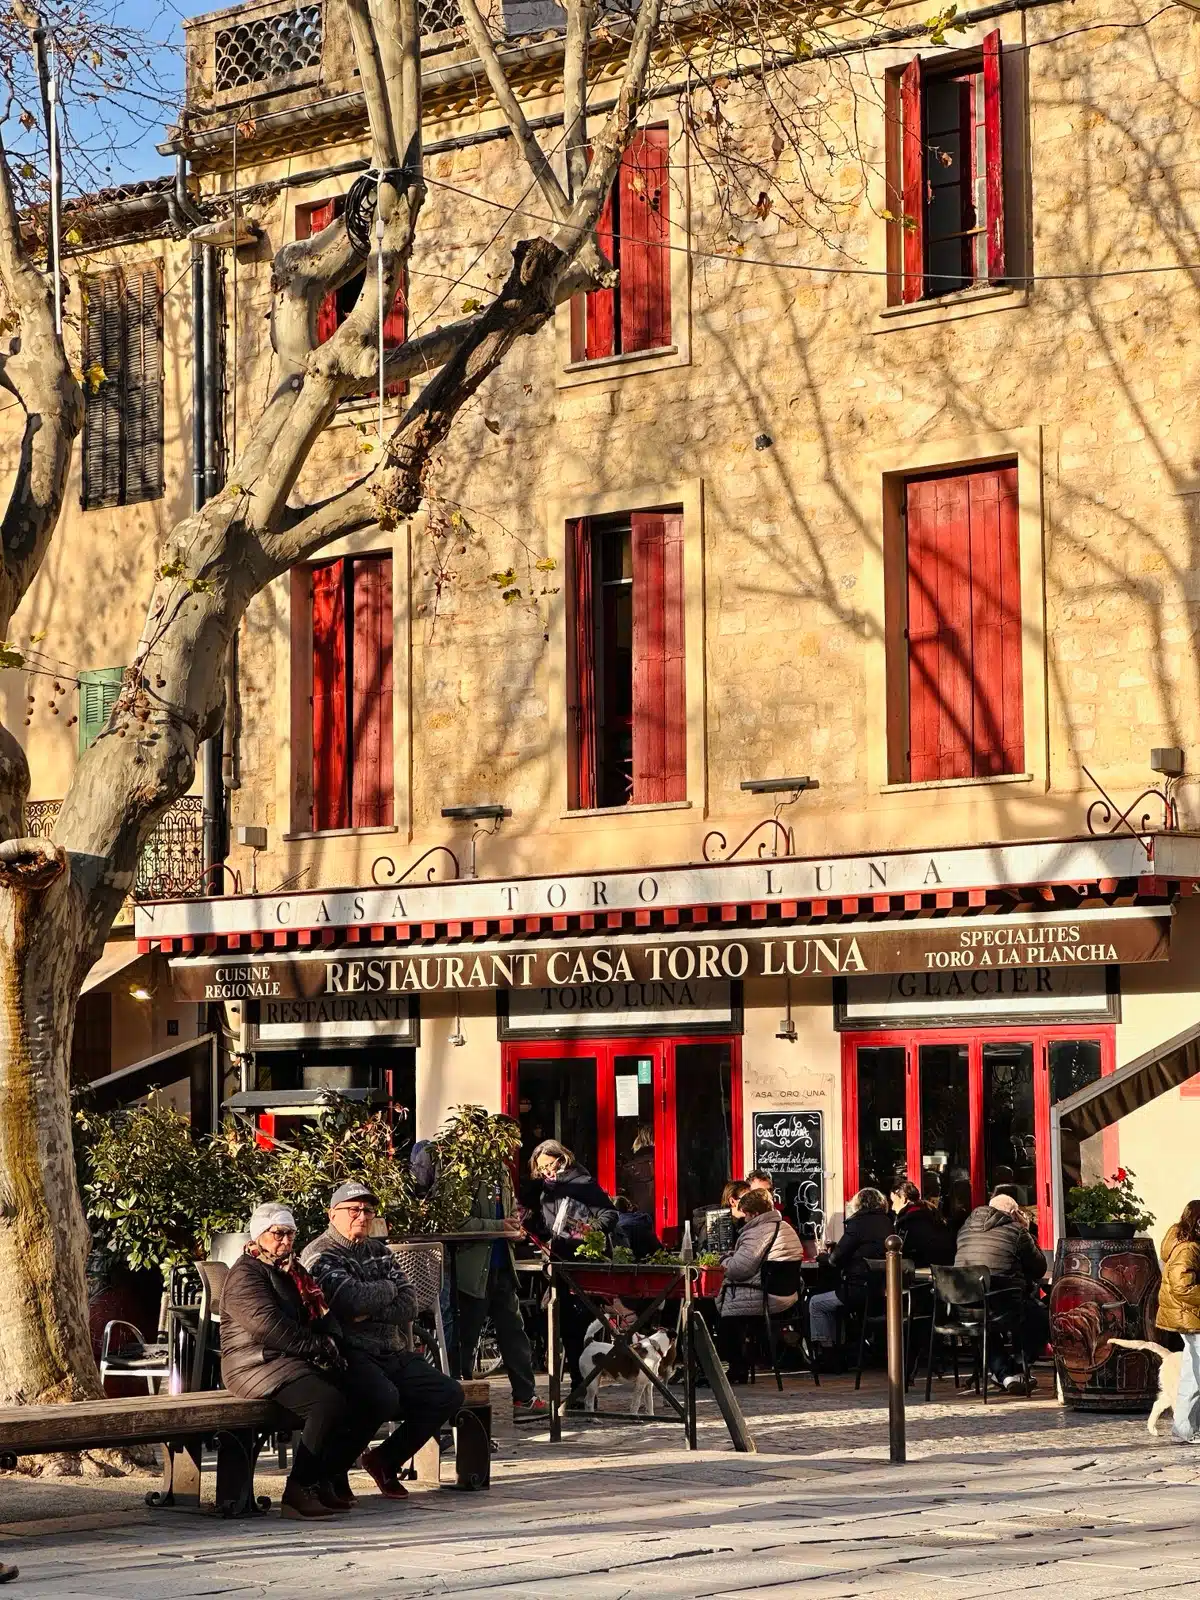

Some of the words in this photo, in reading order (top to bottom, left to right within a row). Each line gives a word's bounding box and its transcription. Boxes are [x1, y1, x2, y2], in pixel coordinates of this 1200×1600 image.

[276, 894, 407, 924] CASA
[501, 876, 659, 911] TORO
[765, 858, 943, 894] LUNA
[960, 926, 1080, 947] SPECIALITES
[324, 953, 538, 993] RESTAURANT
[546, 948, 635, 985] CASA
[644, 943, 748, 980] TORO
[760, 937, 868, 976] LUNA
[925, 947, 974, 968] TORO
[981, 949, 992, 965] A
[998, 948, 1021, 964] LA
[1027, 944, 1118, 963] PLANCHA
[215, 966, 270, 982] CUISINE
[898, 966, 1053, 997] GLACIER
[205, 982, 280, 998] REGIONALE
[541, 984, 614, 1011] TORO
[624, 982, 696, 1006] LUNA
[267, 998, 406, 1024] RESTAURANT
[751, 1090, 773, 1099] ASA
